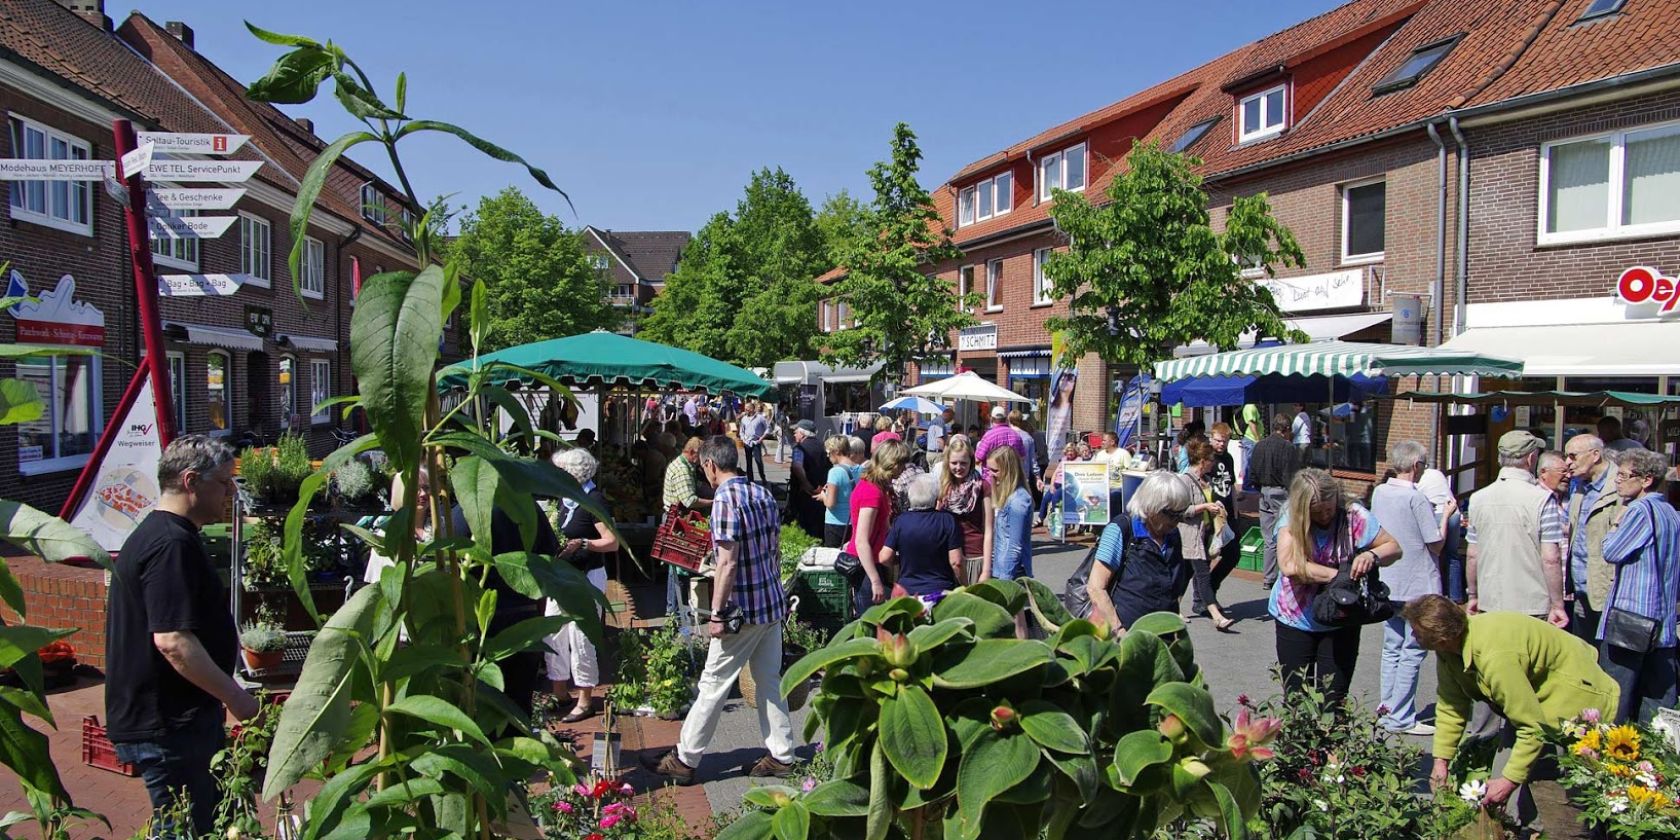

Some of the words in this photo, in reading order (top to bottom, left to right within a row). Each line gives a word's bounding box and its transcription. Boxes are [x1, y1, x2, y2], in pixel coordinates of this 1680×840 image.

[0, 164, 47, 172] Modehaus
[149, 164, 168, 173] EWE
[170, 164, 184, 173] TEL
[187, 164, 241, 174] ServicePunkt
[179, 193, 223, 201] Geschenke
[187, 222, 208, 230] Bode
[167, 279, 182, 288] Bag
[189, 279, 204, 288] Bag
[211, 279, 227, 288] Bag
[966, 334, 995, 348] SCHMITZ
[117, 440, 155, 448] Wegweiser
